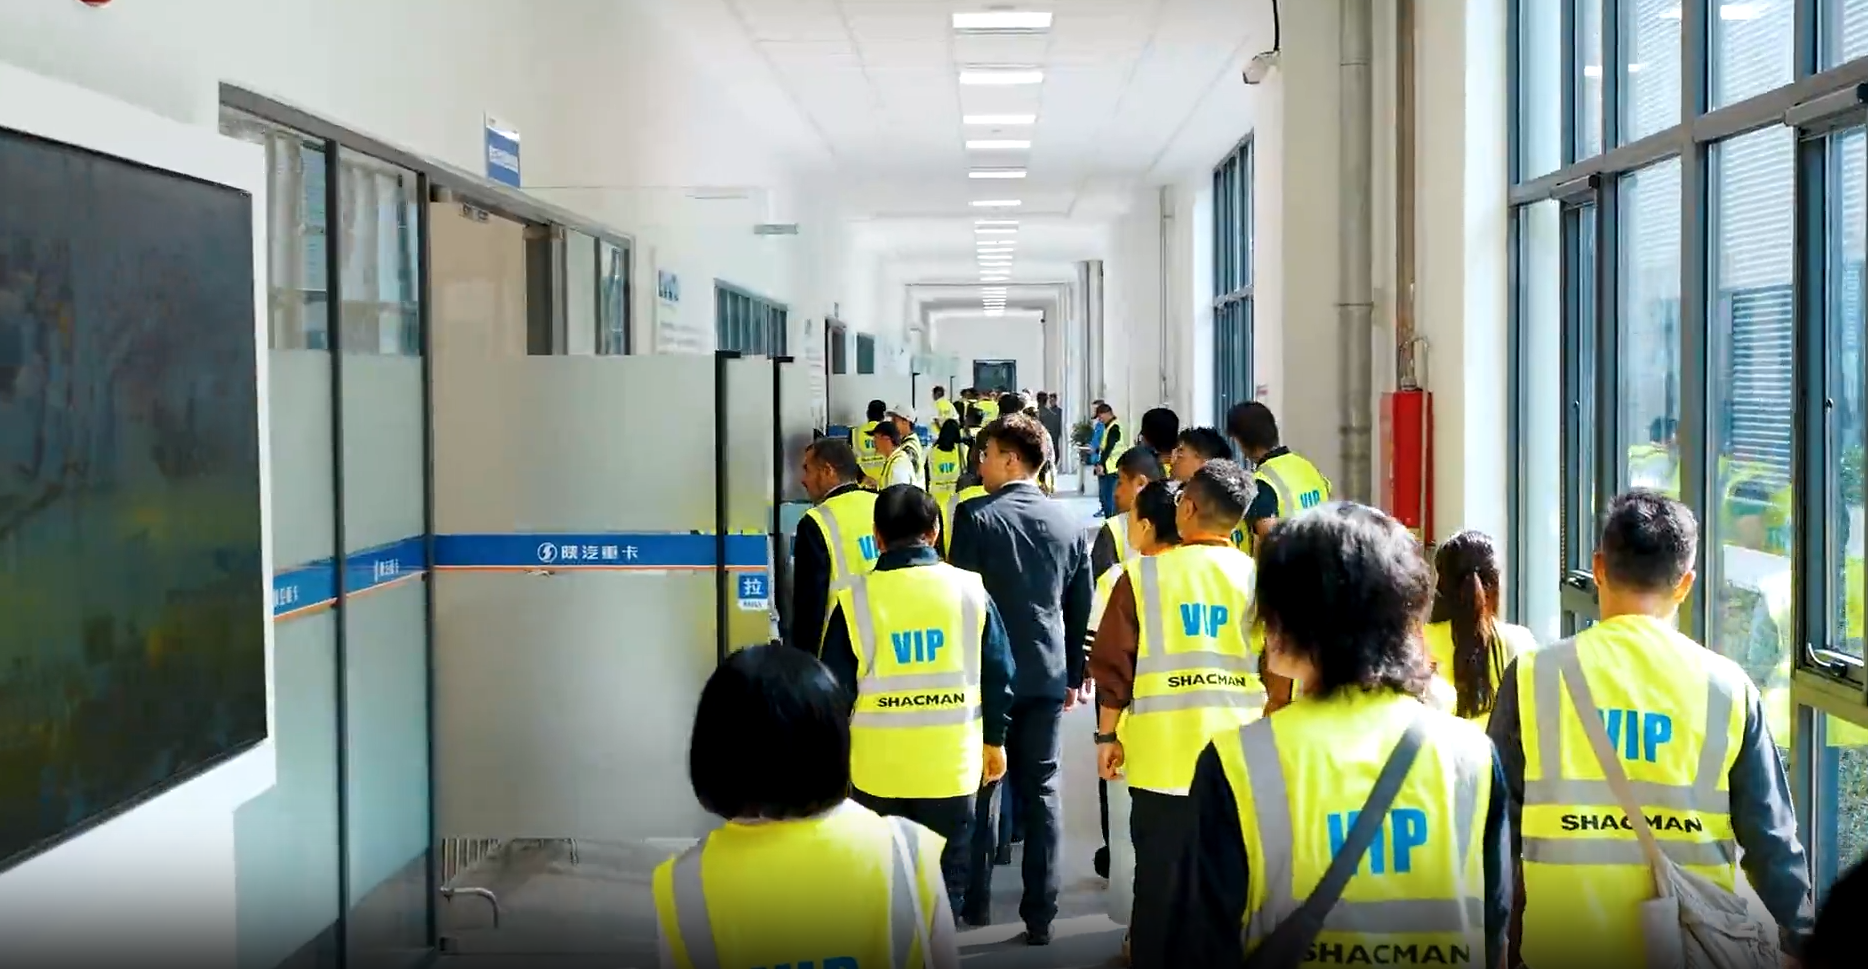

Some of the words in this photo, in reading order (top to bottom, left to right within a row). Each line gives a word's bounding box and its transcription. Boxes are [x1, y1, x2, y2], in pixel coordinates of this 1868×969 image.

[1300, 490, 1320, 509] VIP
[561, 545, 638, 560] 陕汽重卡
[858, 535, 878, 560] VI
[743, 578, 762, 595] 拉
[1180, 603, 1228, 638] VIP
[891, 629, 944, 664] VIP
[1167, 674, 1246, 687] SHACMAN
[878, 693, 965, 707] SHACMAN
